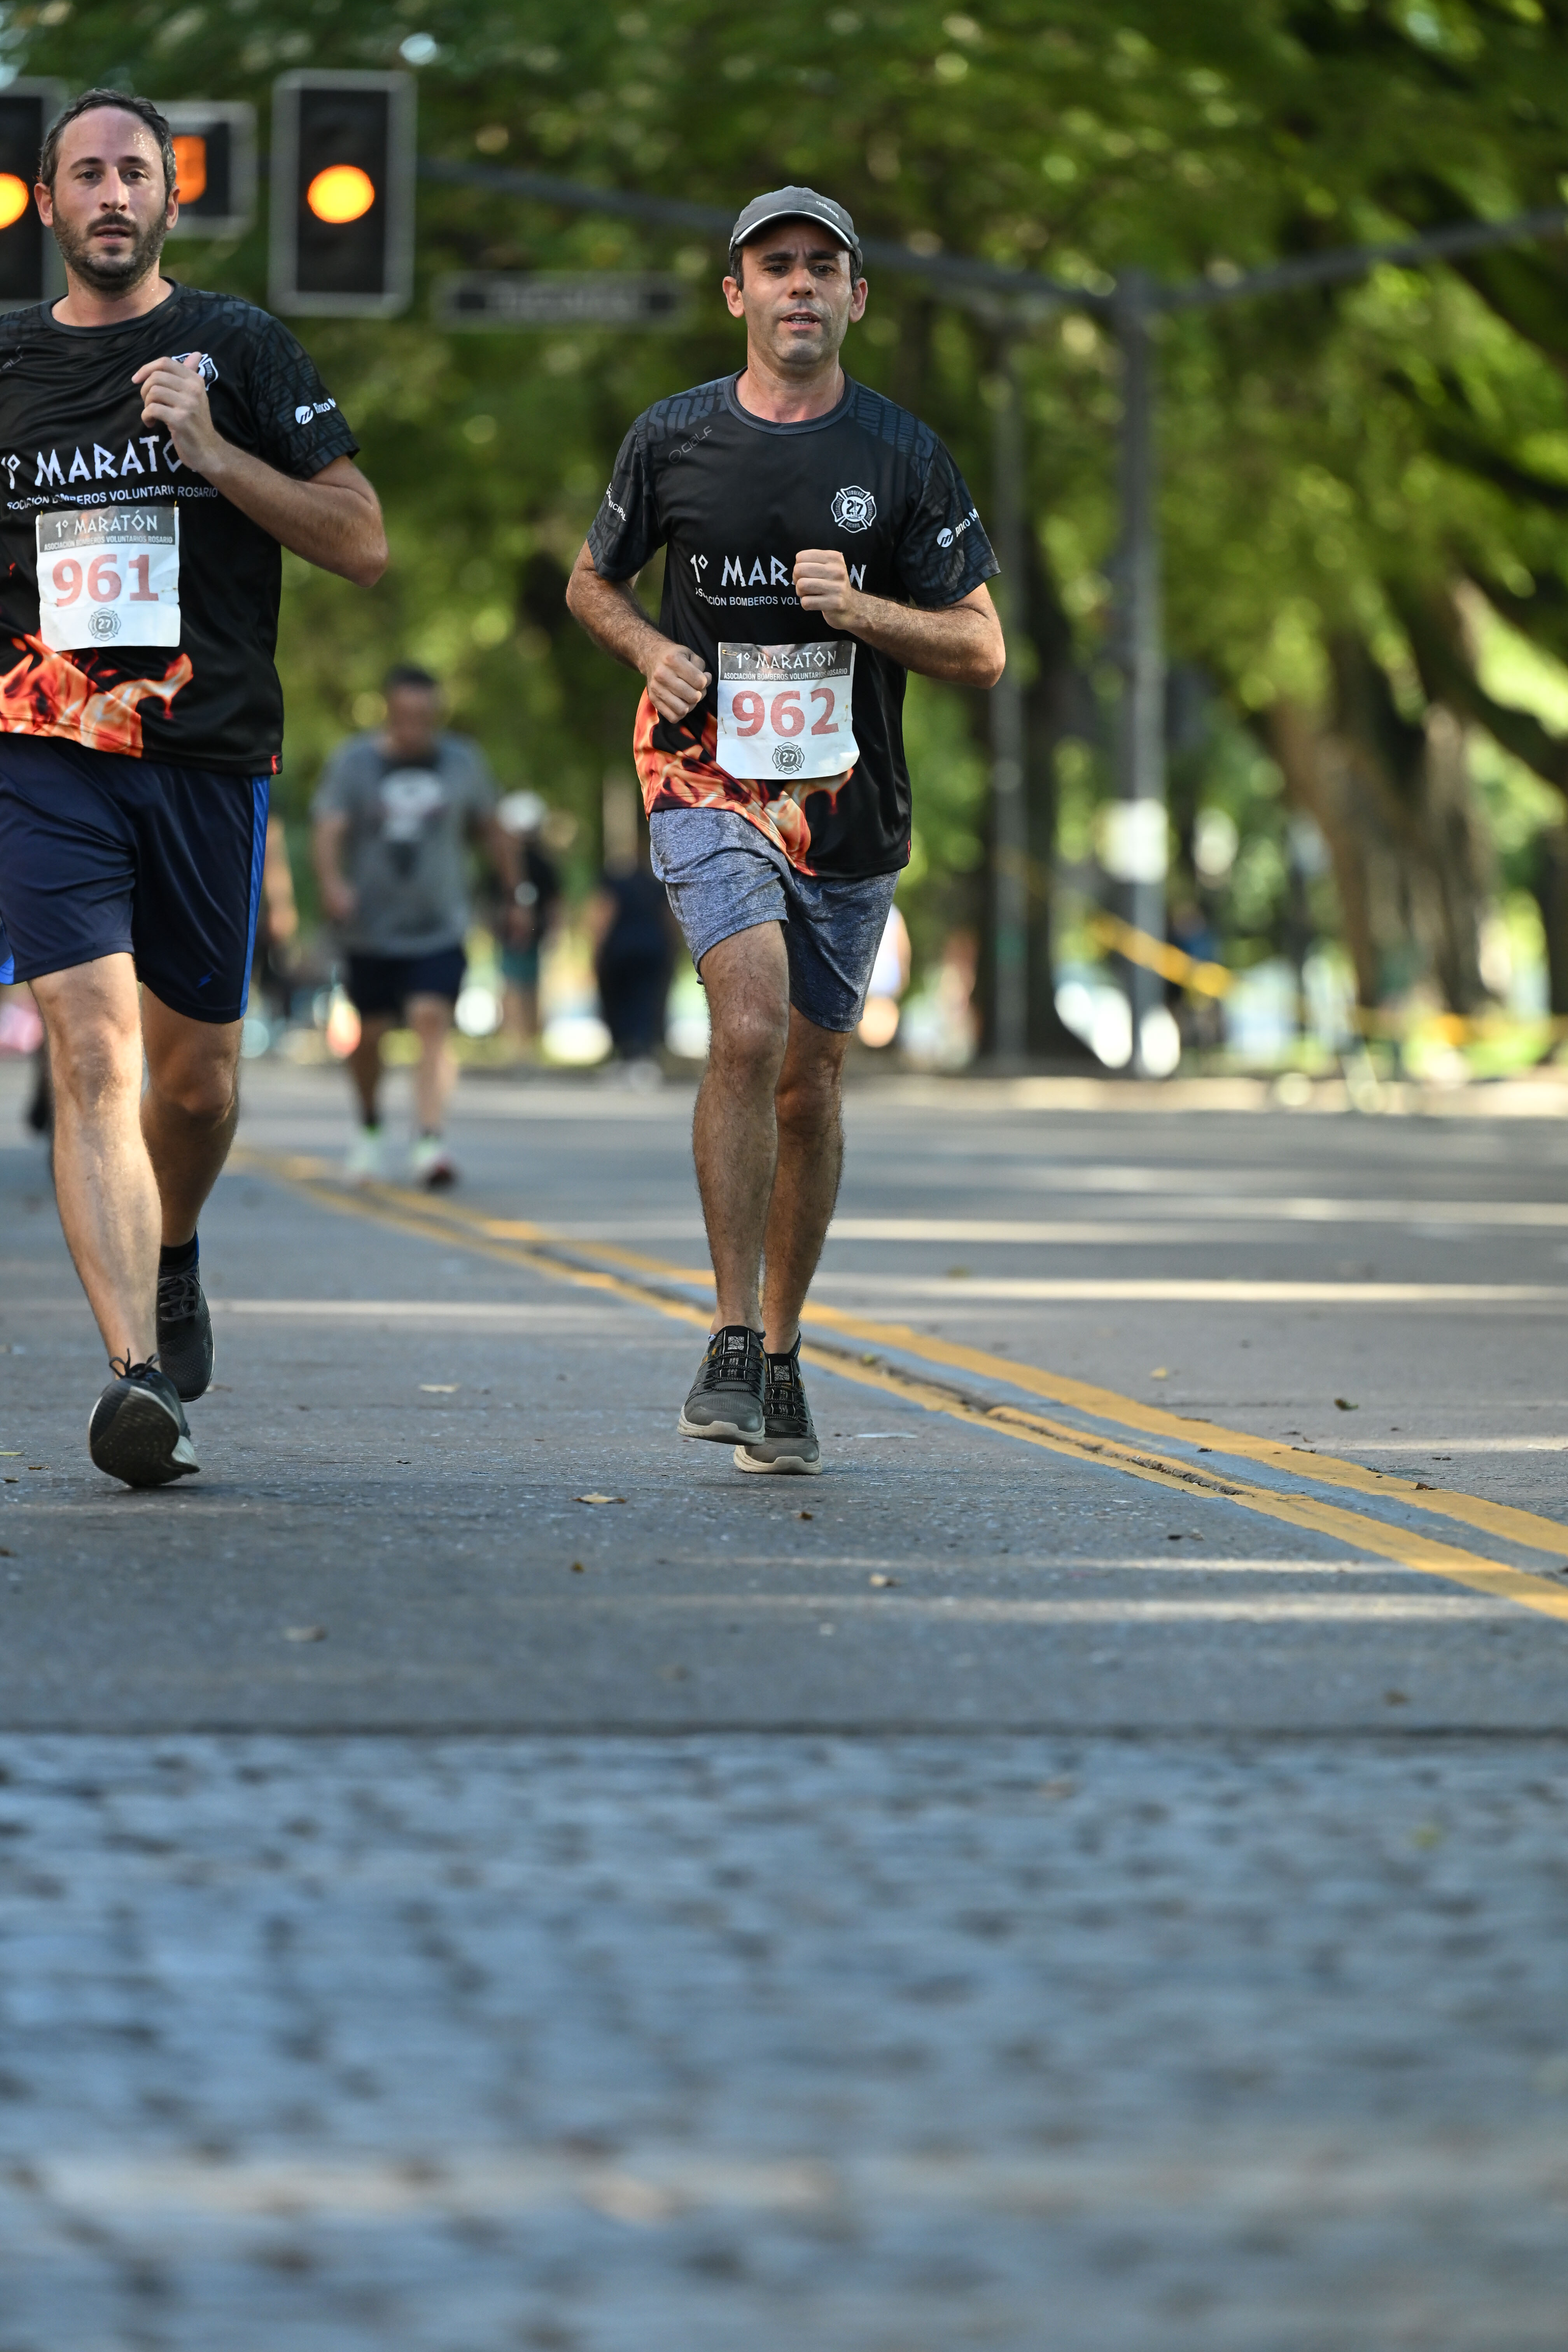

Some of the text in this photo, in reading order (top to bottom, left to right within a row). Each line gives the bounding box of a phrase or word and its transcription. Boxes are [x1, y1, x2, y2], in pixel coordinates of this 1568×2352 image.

[35, 435, 182, 486] MARAT
[109, 485, 175, 501] VOLUNTARI
[177, 486, 218, 498] ROSARIO
[846, 499, 864, 514] 27
[74, 510, 158, 536] MARATÓN
[147, 536, 173, 544] ROSARIO
[52, 554, 159, 607] 961
[721, 555, 867, 590] MARN
[730, 596, 778, 606] BOMBEROS
[98, 618, 111, 630] 27
[756, 646, 836, 669] MARATÓN
[724, 671, 756, 680] ASOCIACIÓN
[789, 671, 826, 680] VOLUNTARIOS
[732, 688, 839, 737] 962
[782, 752, 795, 763] 27
